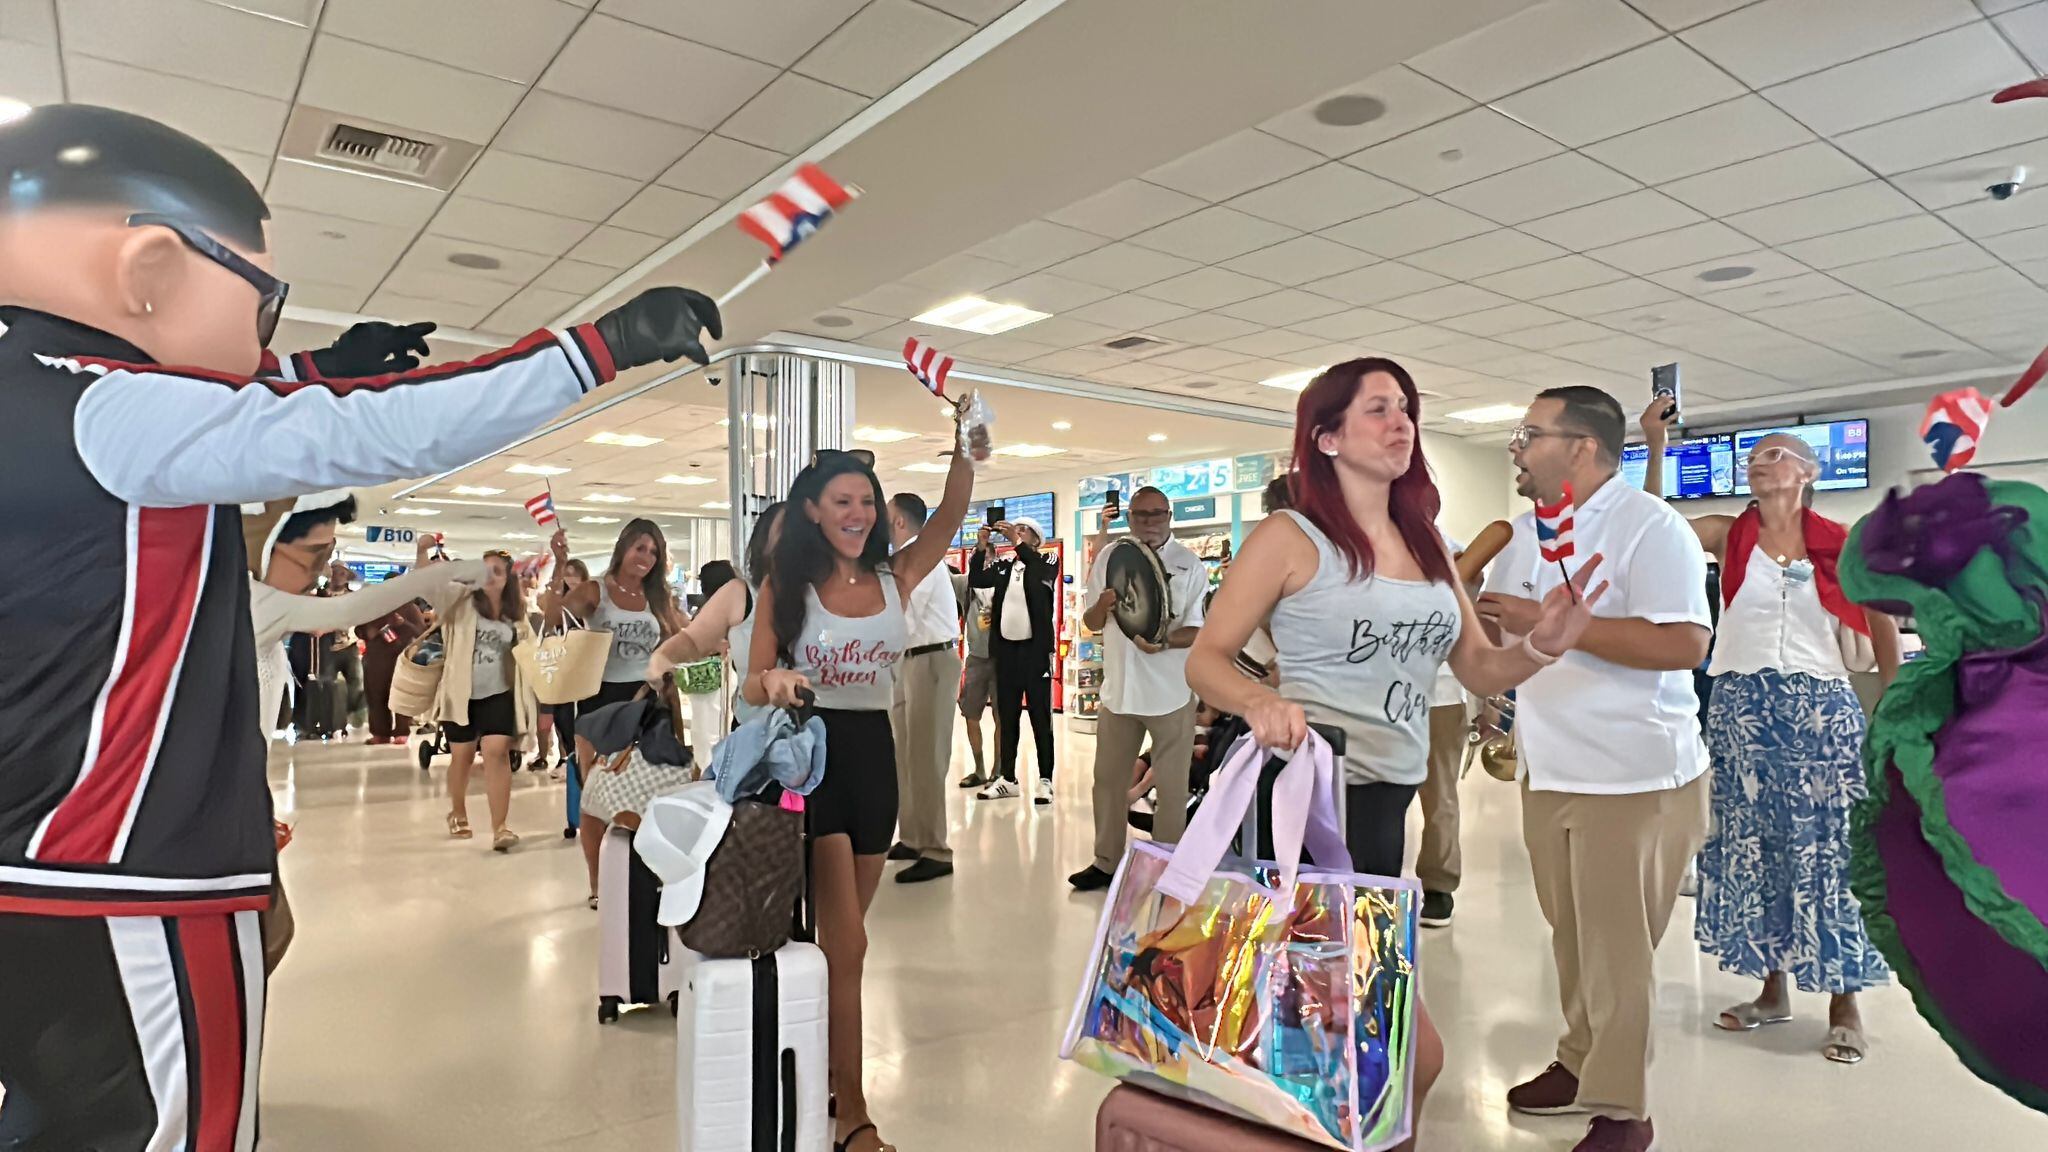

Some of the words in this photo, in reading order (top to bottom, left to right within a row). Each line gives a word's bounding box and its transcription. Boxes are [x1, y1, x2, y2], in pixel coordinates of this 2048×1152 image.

[384, 528, 414, 543] B10
[805, 639, 902, 669] Birthday
[819, 664, 877, 688] Queen
